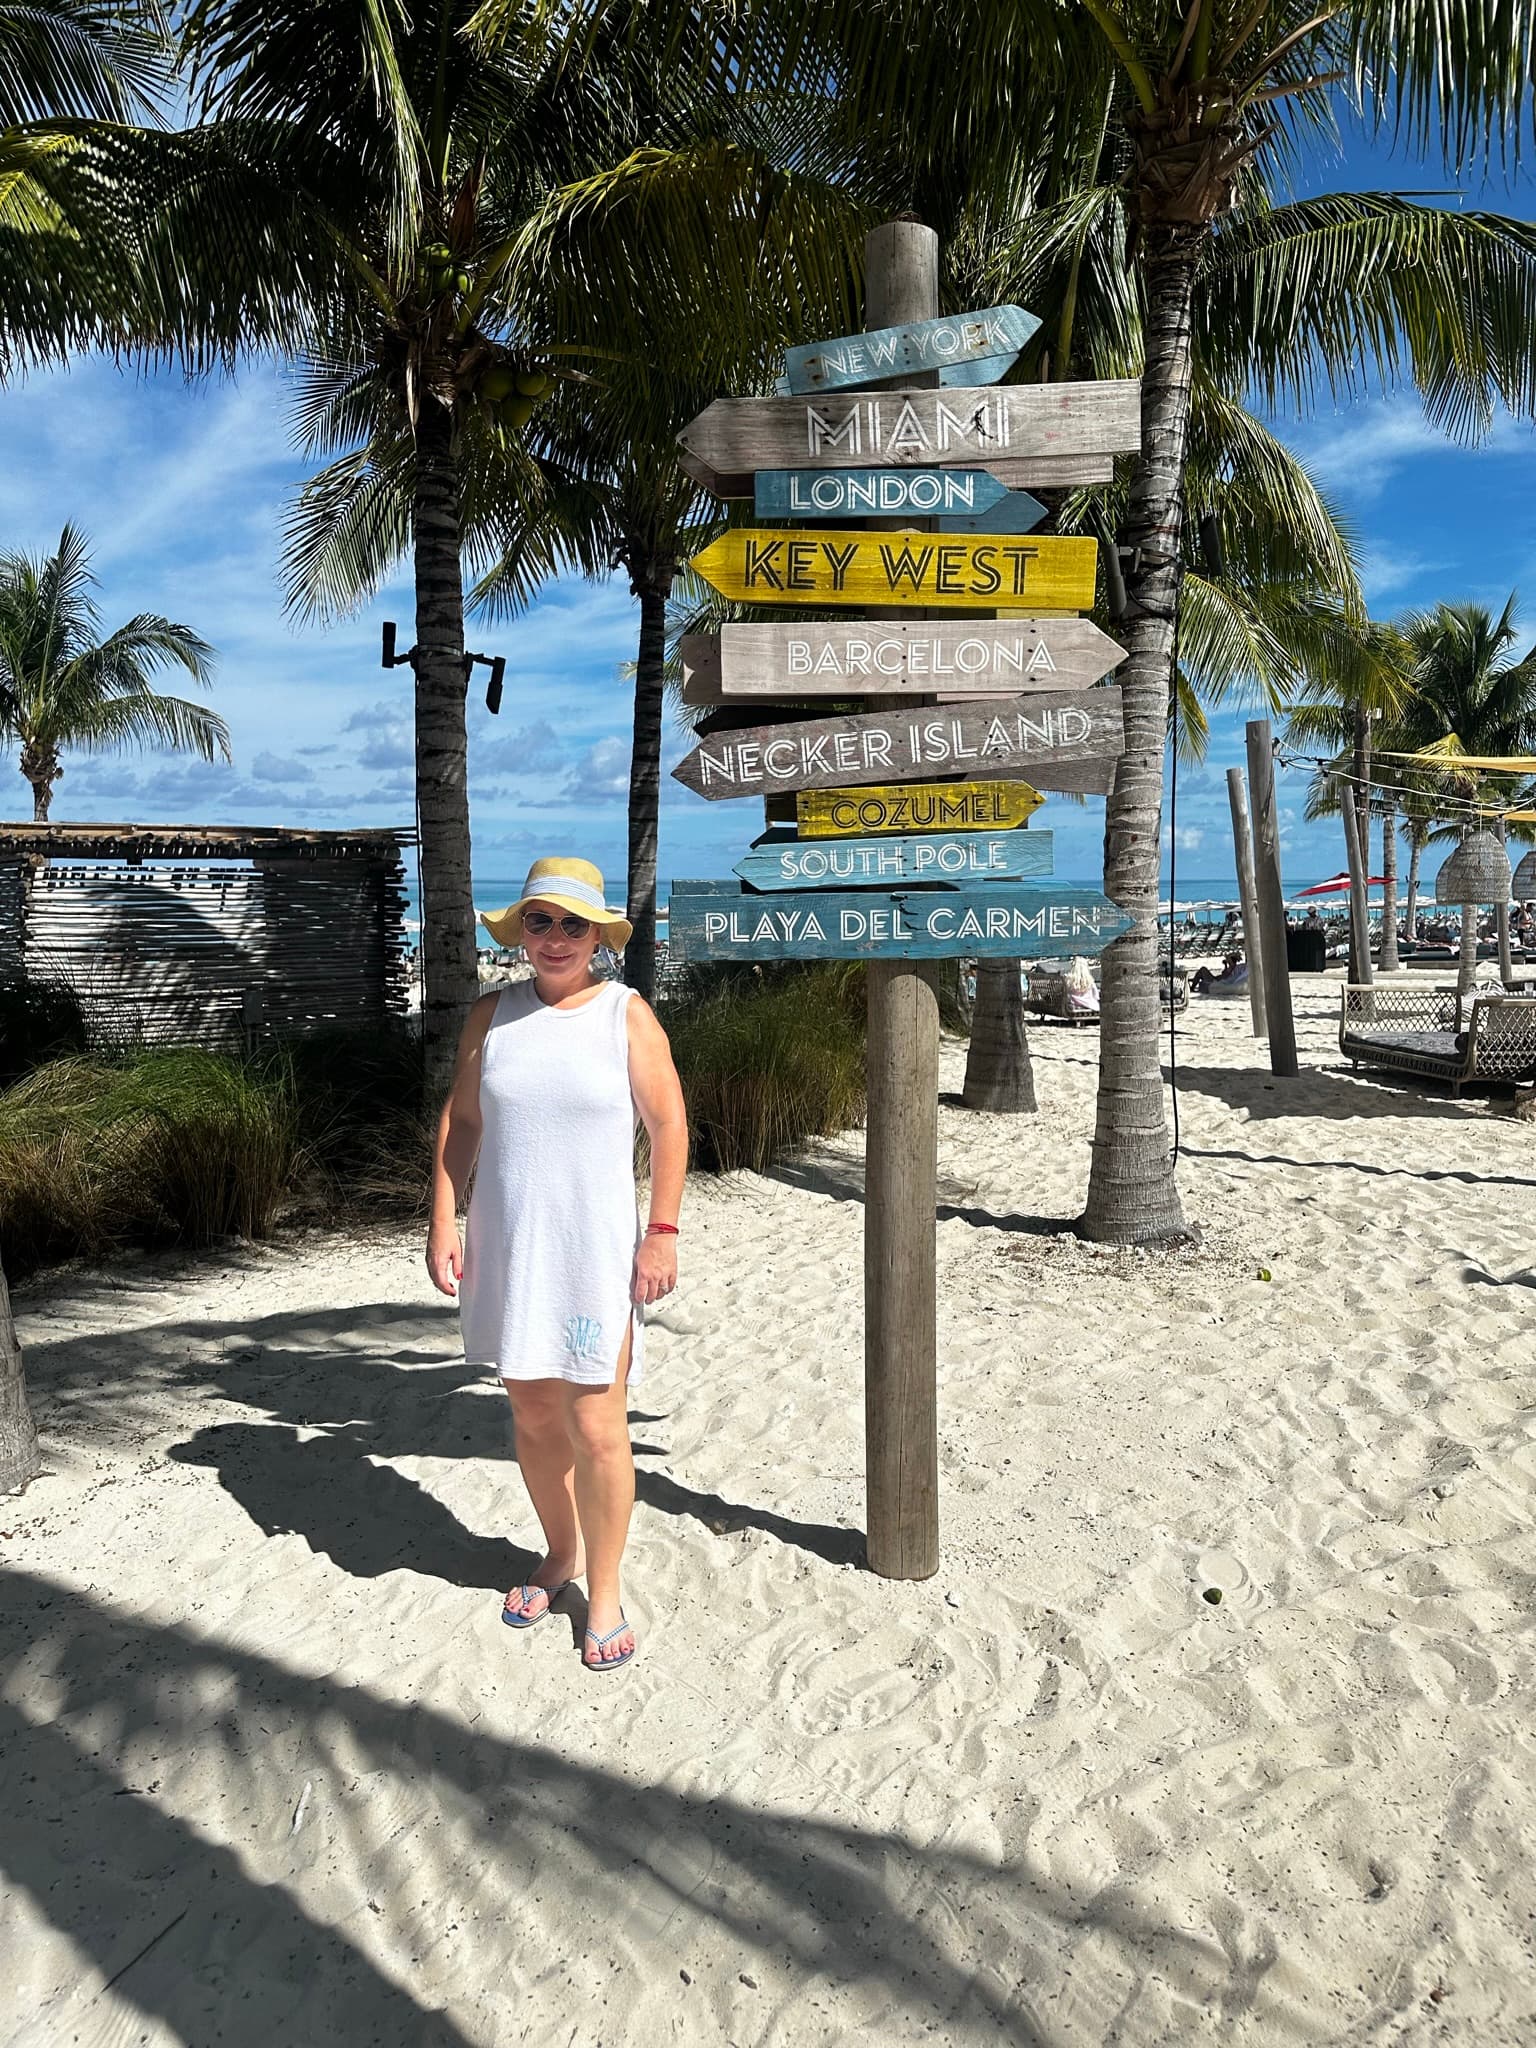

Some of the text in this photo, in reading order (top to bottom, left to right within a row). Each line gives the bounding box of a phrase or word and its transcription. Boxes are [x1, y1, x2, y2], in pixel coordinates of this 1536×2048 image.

[819, 316, 1011, 378] NEW YORK
[806, 398, 1009, 457] MIAMI
[789, 474, 974, 509] LONDON
[745, 540, 1039, 596] KEY WEST
[788, 638, 1057, 675] BARCELONA
[700, 707, 1092, 786] NECKER ISLAND
[831, 794, 1011, 830] COZUMEL
[780, 841, 1007, 880] SOUTH POLE
[705, 906, 1101, 943] PLAYA DEL CARMEN
